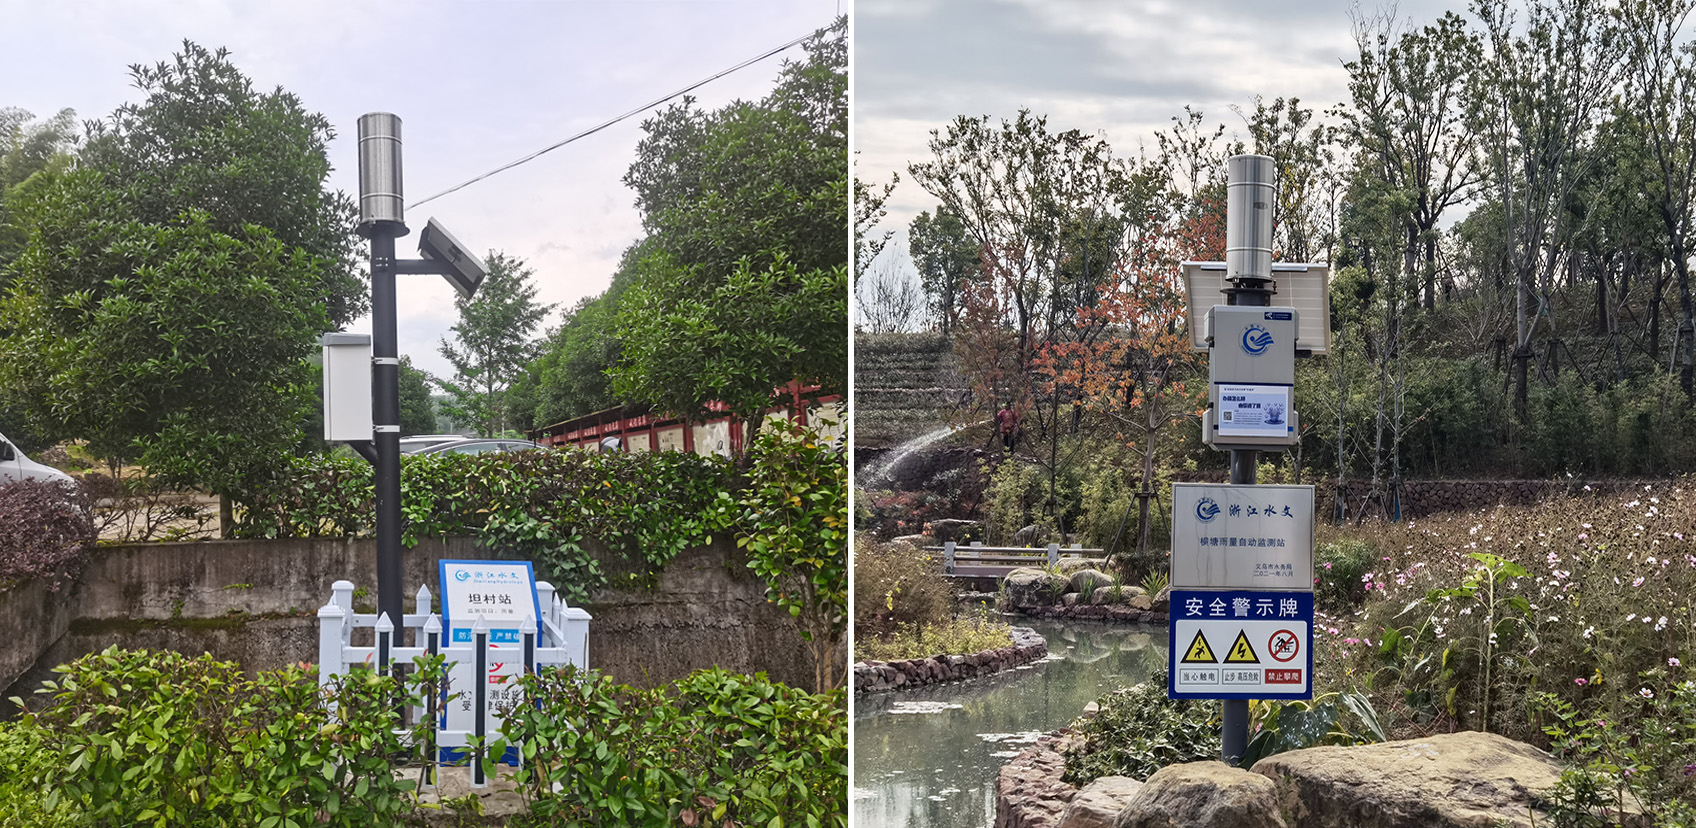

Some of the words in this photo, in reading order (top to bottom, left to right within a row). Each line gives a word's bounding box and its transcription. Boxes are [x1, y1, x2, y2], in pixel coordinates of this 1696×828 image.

[1228, 504, 1294, 518] 浙江水文
[1255, 563, 1293, 571] 义乌市水务局
[474, 571, 519, 580] 浙江水文
[469, 593, 512, 604] 坦村站
[1185, 597, 1299, 618] 安全警示牌
[1183, 671, 1216, 682] 当心触电
[1224, 671, 1236, 682] 止步
[1237, 671, 1259, 682] 高压危险
[1268, 671, 1299, 682] 禁止攀爬
